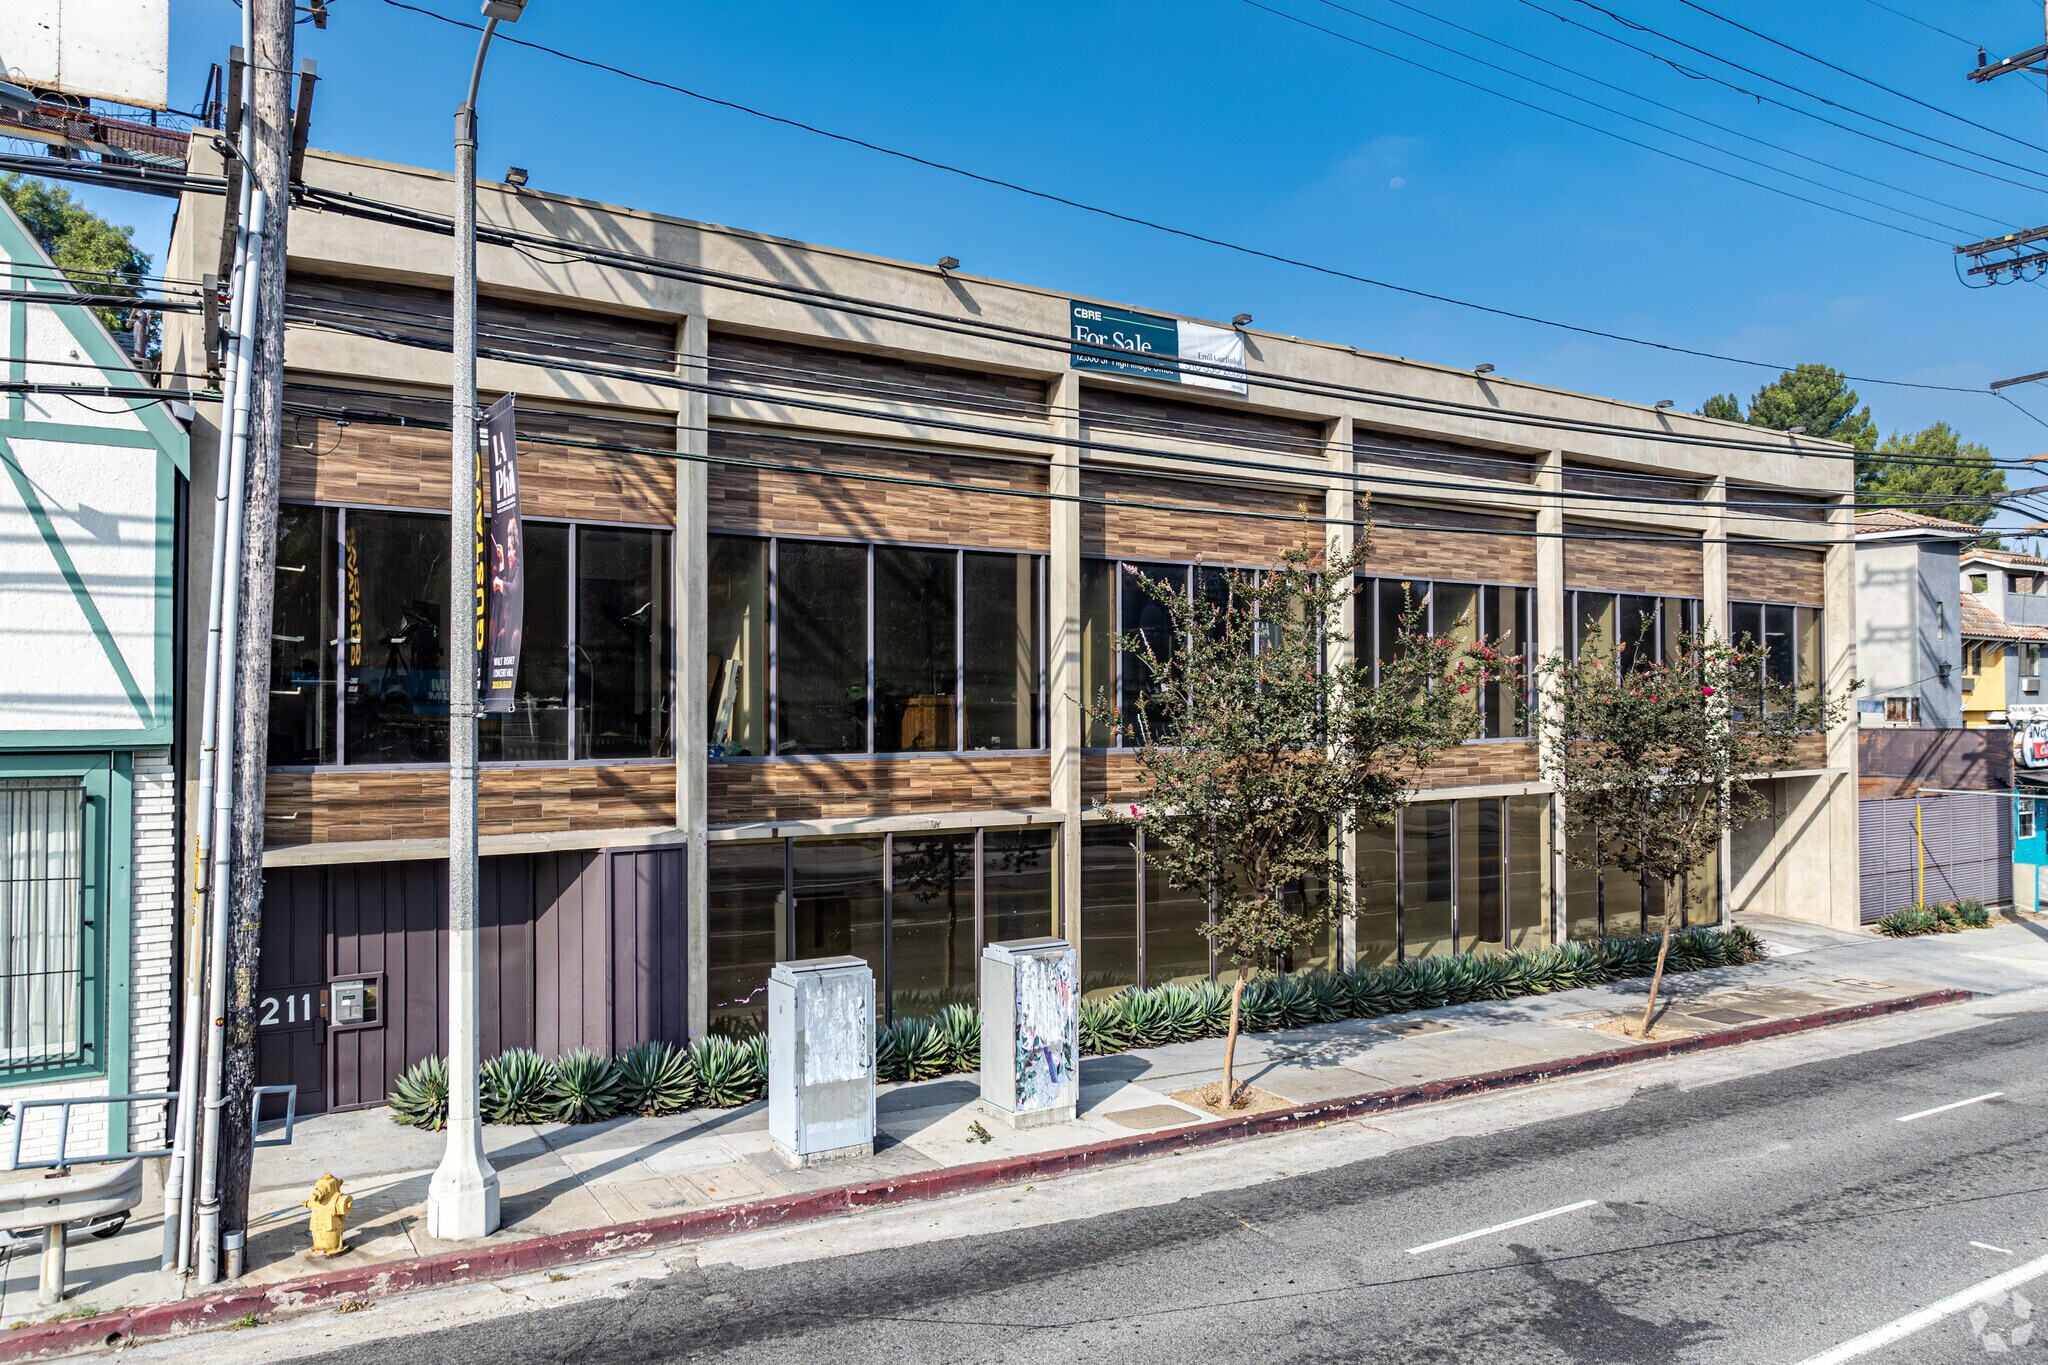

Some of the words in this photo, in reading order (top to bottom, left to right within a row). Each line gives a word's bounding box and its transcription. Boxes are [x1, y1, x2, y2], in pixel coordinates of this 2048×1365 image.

[1074, 307, 1102, 321] CBRE
[1075, 325, 1108, 346] For
[1112, 331, 1152, 354] Sale
[493, 432, 507, 467] LA
[259, 993, 311, 1026] 211
